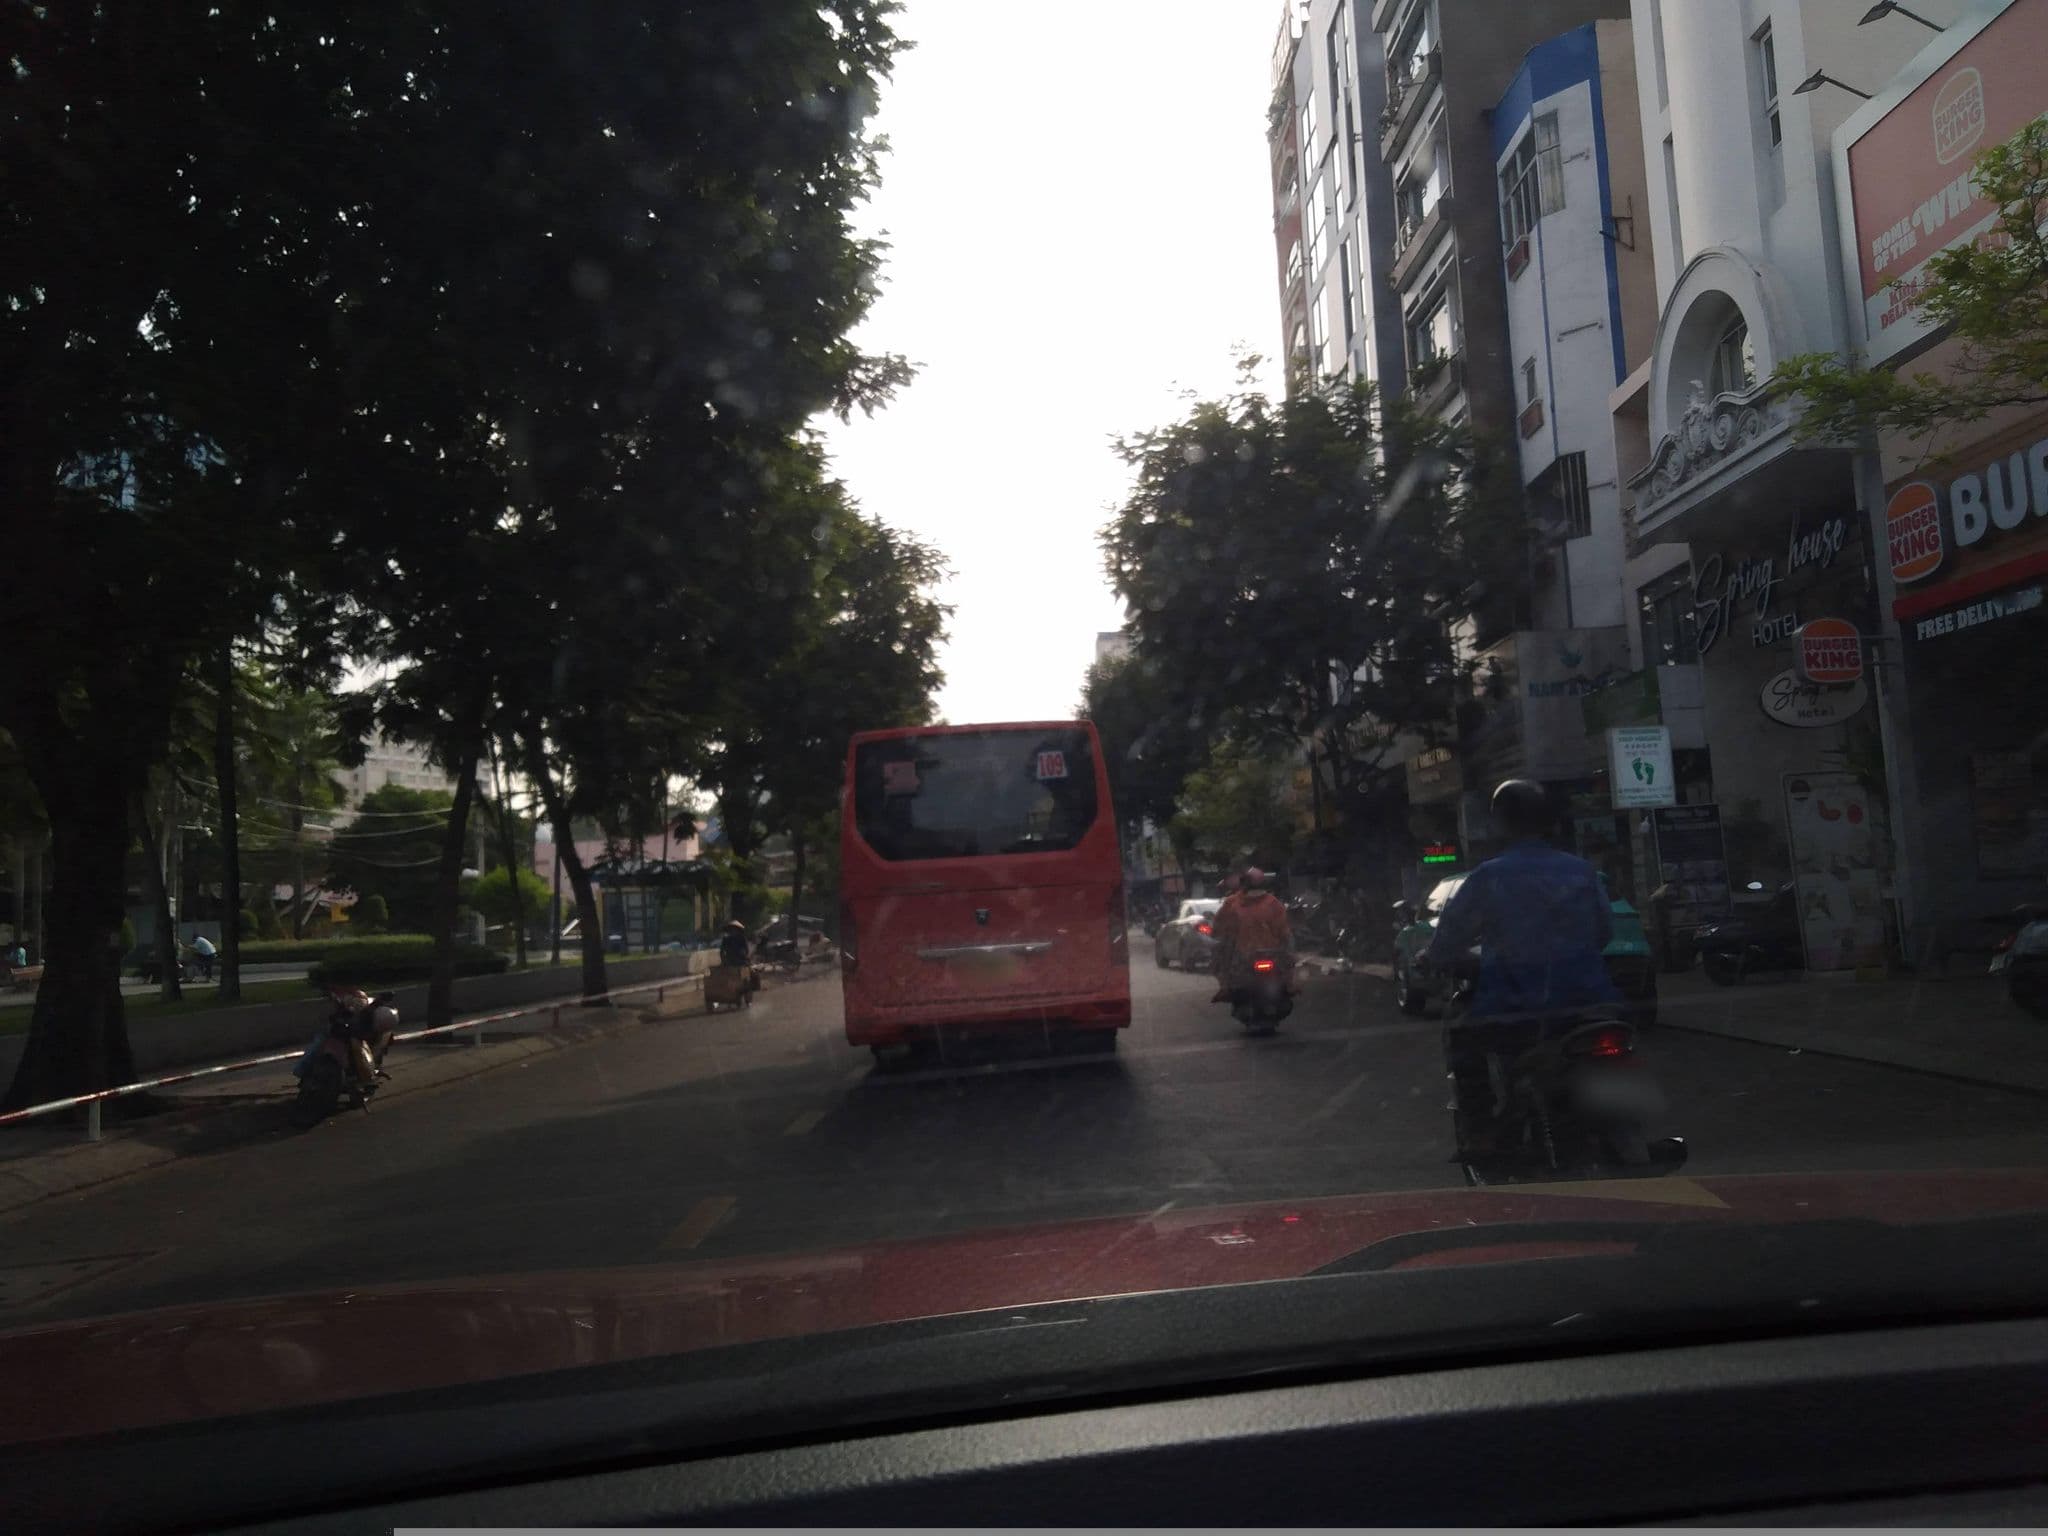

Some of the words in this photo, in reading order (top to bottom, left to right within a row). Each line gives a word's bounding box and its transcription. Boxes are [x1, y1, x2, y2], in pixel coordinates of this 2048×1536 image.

[1935, 86, 1981, 131] BURGER
[1937, 103, 1982, 150] KING
[1872, 217, 1911, 257] HOME
[1873, 251, 1892, 273] OF
[1892, 234, 1918, 261] THE
[1887, 504, 1938, 541] BURGER
[1889, 525, 1940, 567] KING
[1694, 553, 1784, 655] Spring
[1788, 514, 1846, 574] house
[1752, 611, 1800, 648] HOTEL
[1803, 638, 1859, 652] BURGER
[1916, 613, 1954, 641] FREE
[1804, 651, 1861, 669] KING
[1040, 753, 1063, 777] 109
